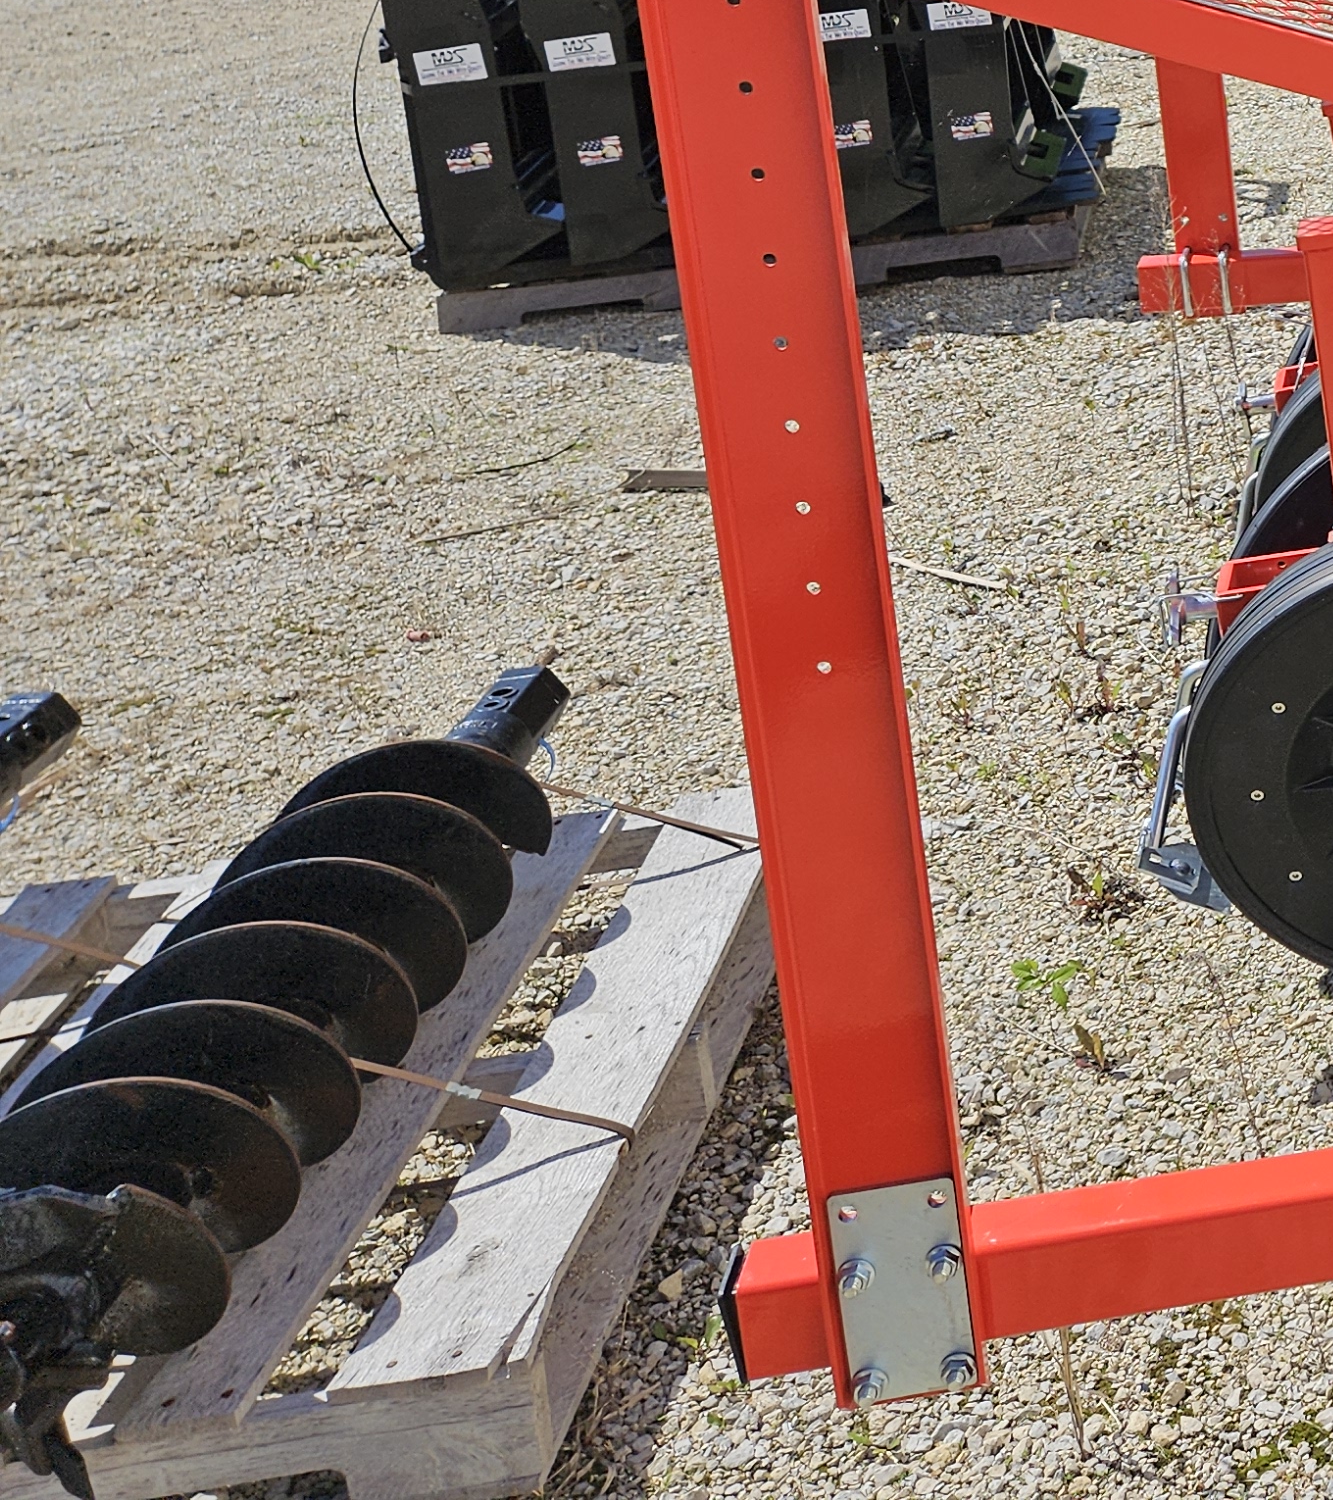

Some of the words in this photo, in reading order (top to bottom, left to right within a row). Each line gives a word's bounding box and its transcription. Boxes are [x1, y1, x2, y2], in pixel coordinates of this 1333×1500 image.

[821, 12, 855, 30] MDS
[562, 37, 597, 55] MDS
[431, 48, 467, 67] MDS
